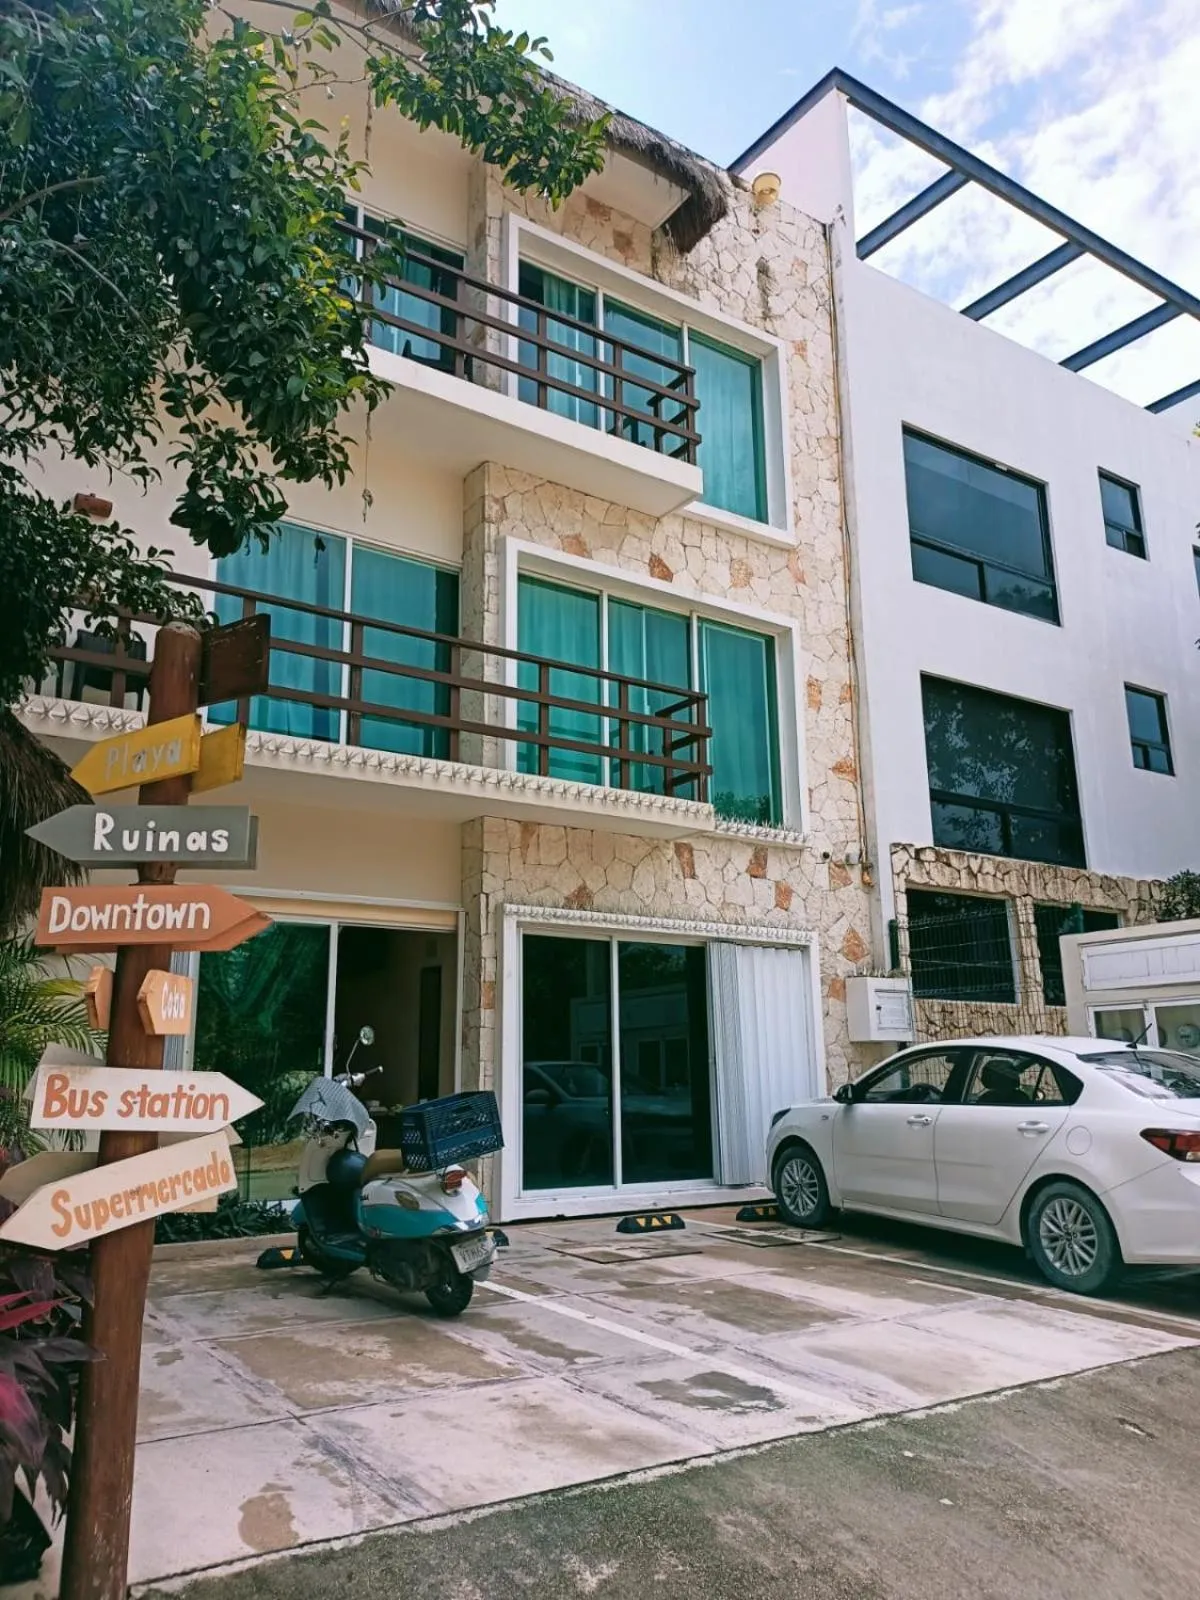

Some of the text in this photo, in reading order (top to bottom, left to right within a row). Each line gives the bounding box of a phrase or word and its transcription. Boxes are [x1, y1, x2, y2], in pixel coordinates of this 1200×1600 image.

[104, 738, 182, 781] Playa
[93, 812, 229, 851] Ruinas
[48, 893, 211, 933] Downtown
[43, 1073, 230, 1120] Bus station
[51, 1151, 230, 1237] Supermercado
